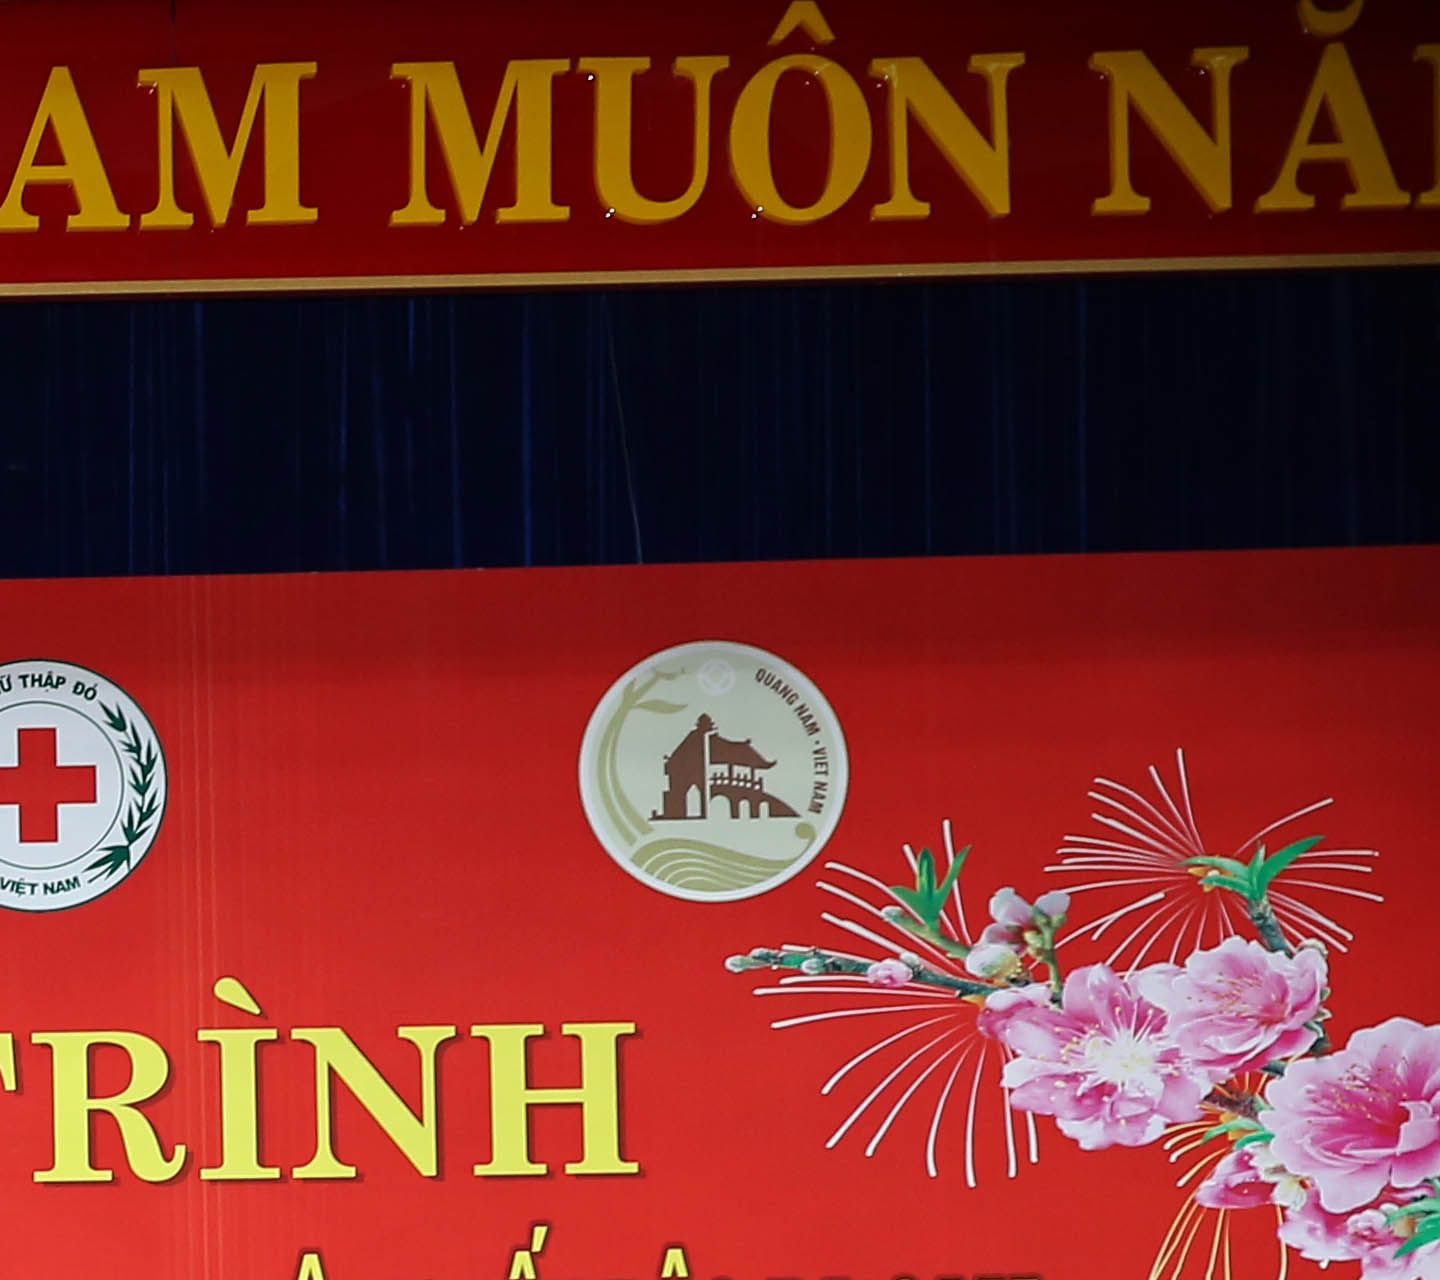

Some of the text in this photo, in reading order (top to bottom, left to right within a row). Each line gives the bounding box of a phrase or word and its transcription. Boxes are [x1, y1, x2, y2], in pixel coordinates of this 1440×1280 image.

[390, 0, 1025, 228] MUÔN
[1088, 0, 1440, 215] NĂ
[18, 671, 67, 692] THẬP
[72, 680, 99, 702] ĐỎ
[755, 668, 821, 736] QUANG NAM
[808, 747, 829, 814] VIET NAM
[0, 876, 81, 897] VIỆT NAM
